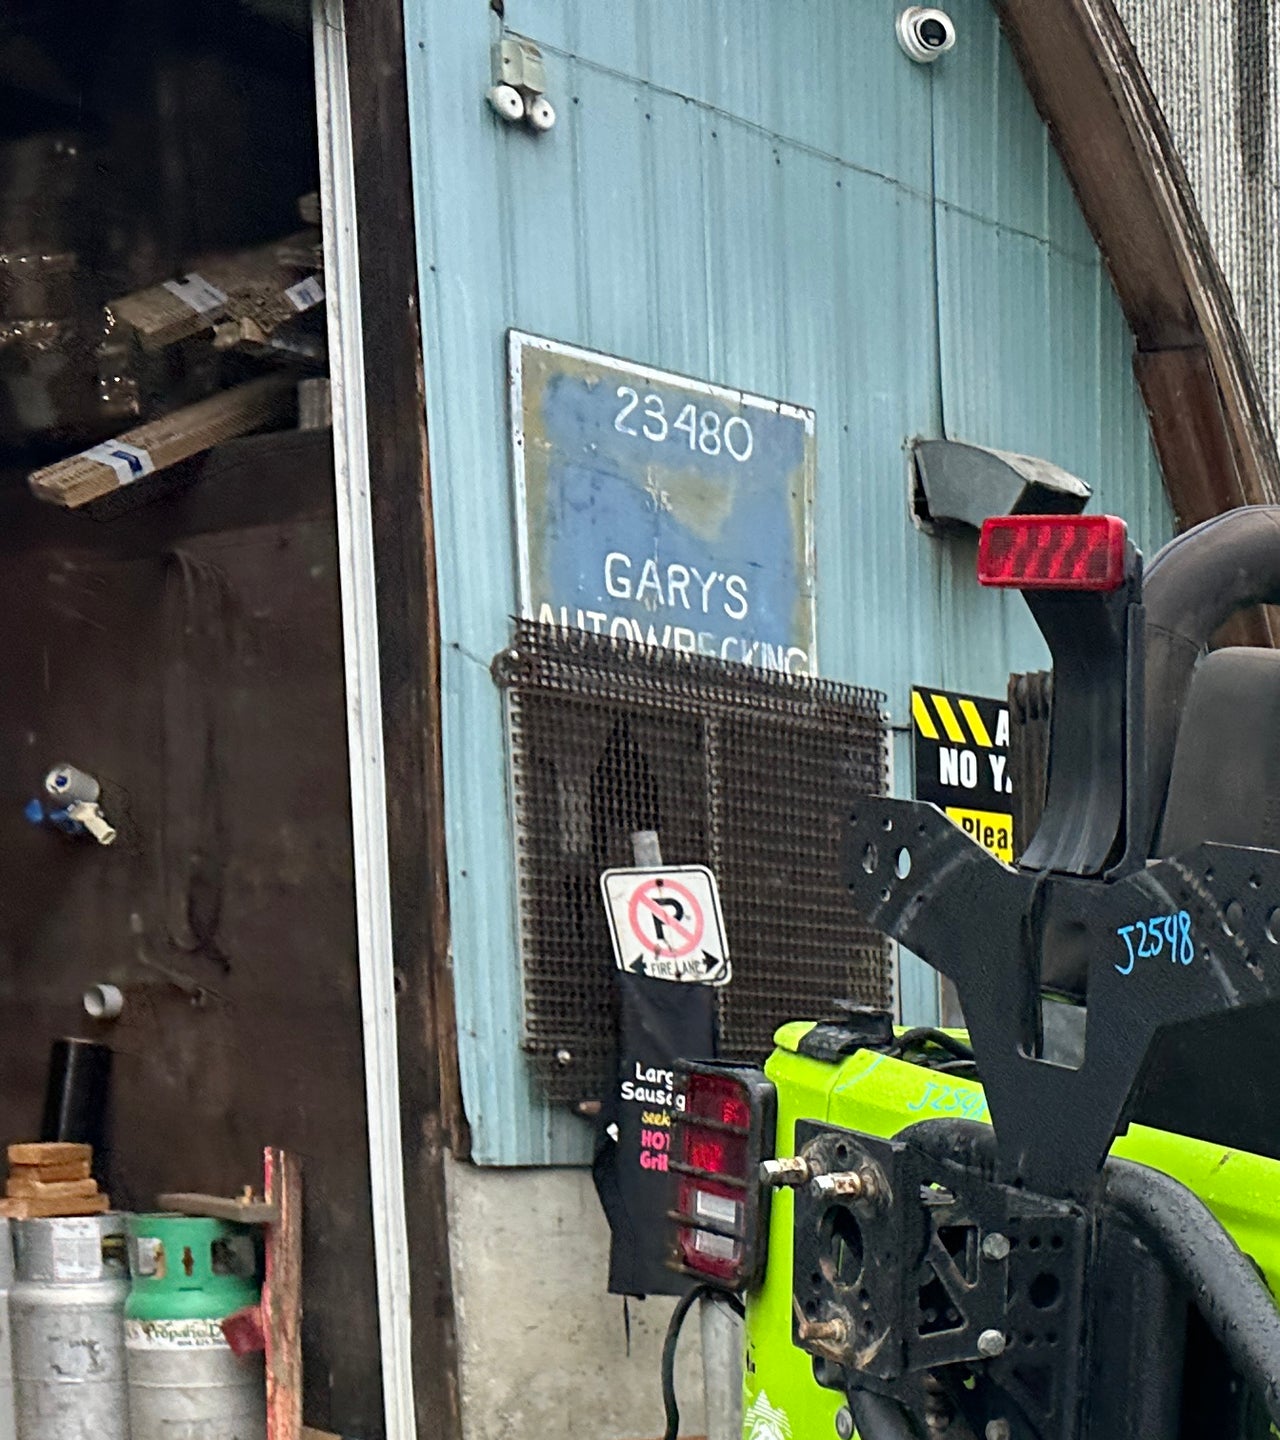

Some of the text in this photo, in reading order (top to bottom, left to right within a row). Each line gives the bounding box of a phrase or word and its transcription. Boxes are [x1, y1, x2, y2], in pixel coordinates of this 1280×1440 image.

[613, 386, 754, 462] 23480
[603, 551, 749, 619] GARY'S
[939, 746, 978, 789] NO
[650, 961, 673, 976] FIRE
[1113, 908, 1195, 976] J2548
